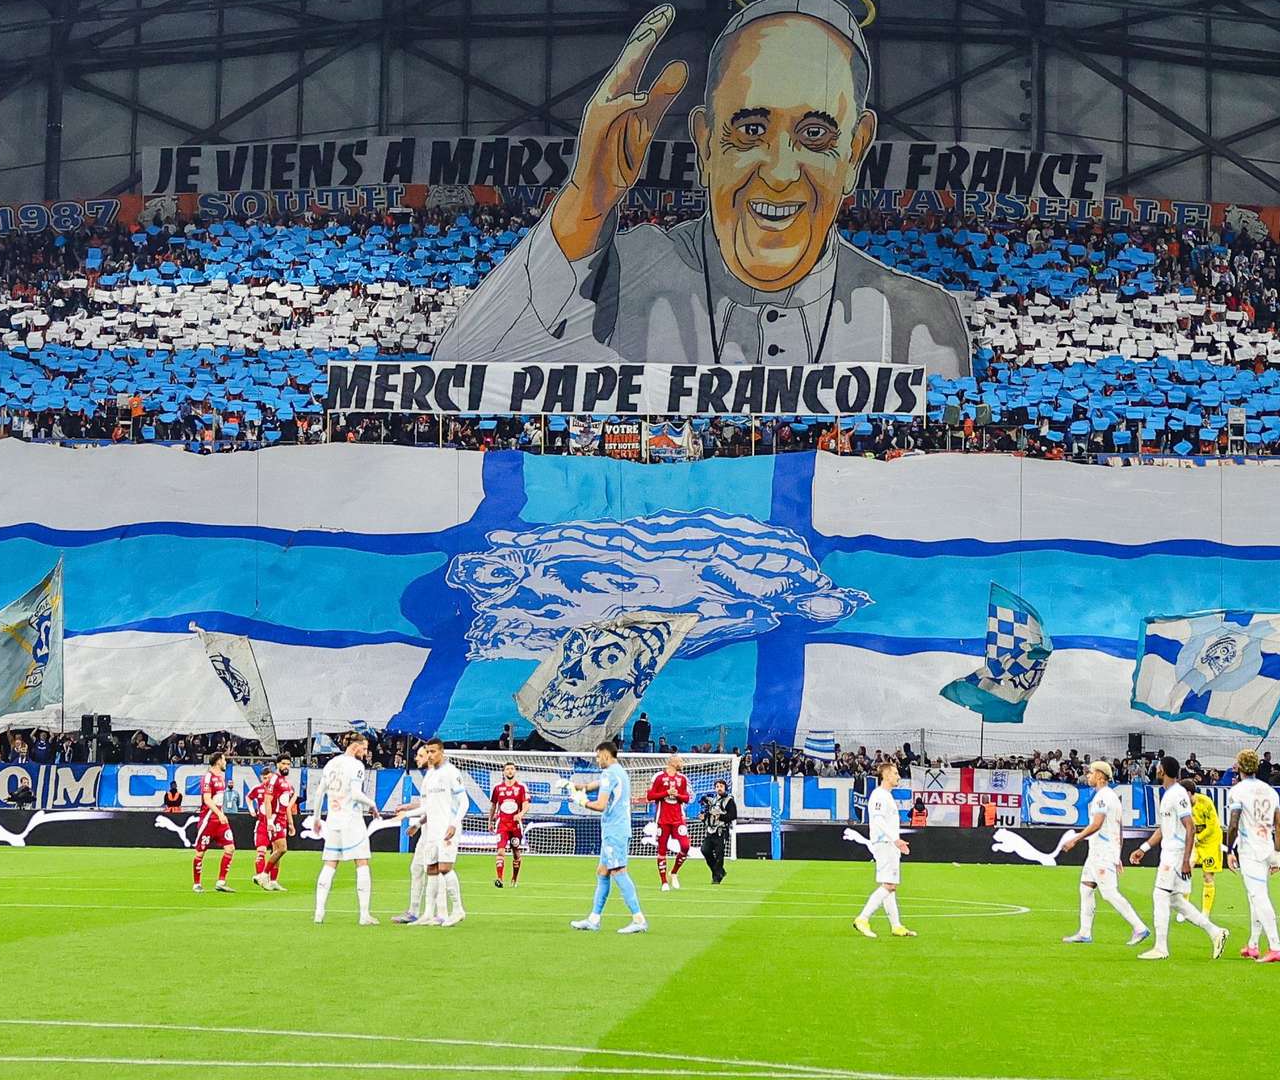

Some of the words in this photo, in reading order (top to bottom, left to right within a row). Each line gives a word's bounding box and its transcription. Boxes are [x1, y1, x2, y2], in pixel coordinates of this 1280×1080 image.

[154, 144, 204, 194] JE
[217, 139, 368, 193] VIENS
[382, 136, 416, 186] A
[906, 144, 1103, 201] FRANCE
[196, 184, 407, 220] SOUTH
[853, 189, 1212, 231] MARSEILLE
[329, 363, 488, 412] MERCI
[518, 364, 644, 412] PAPE
[667, 364, 924, 414] FRANCOIS
[606, 424, 639, 434] VOTRE
[1253, 798, 1270, 820] 62
